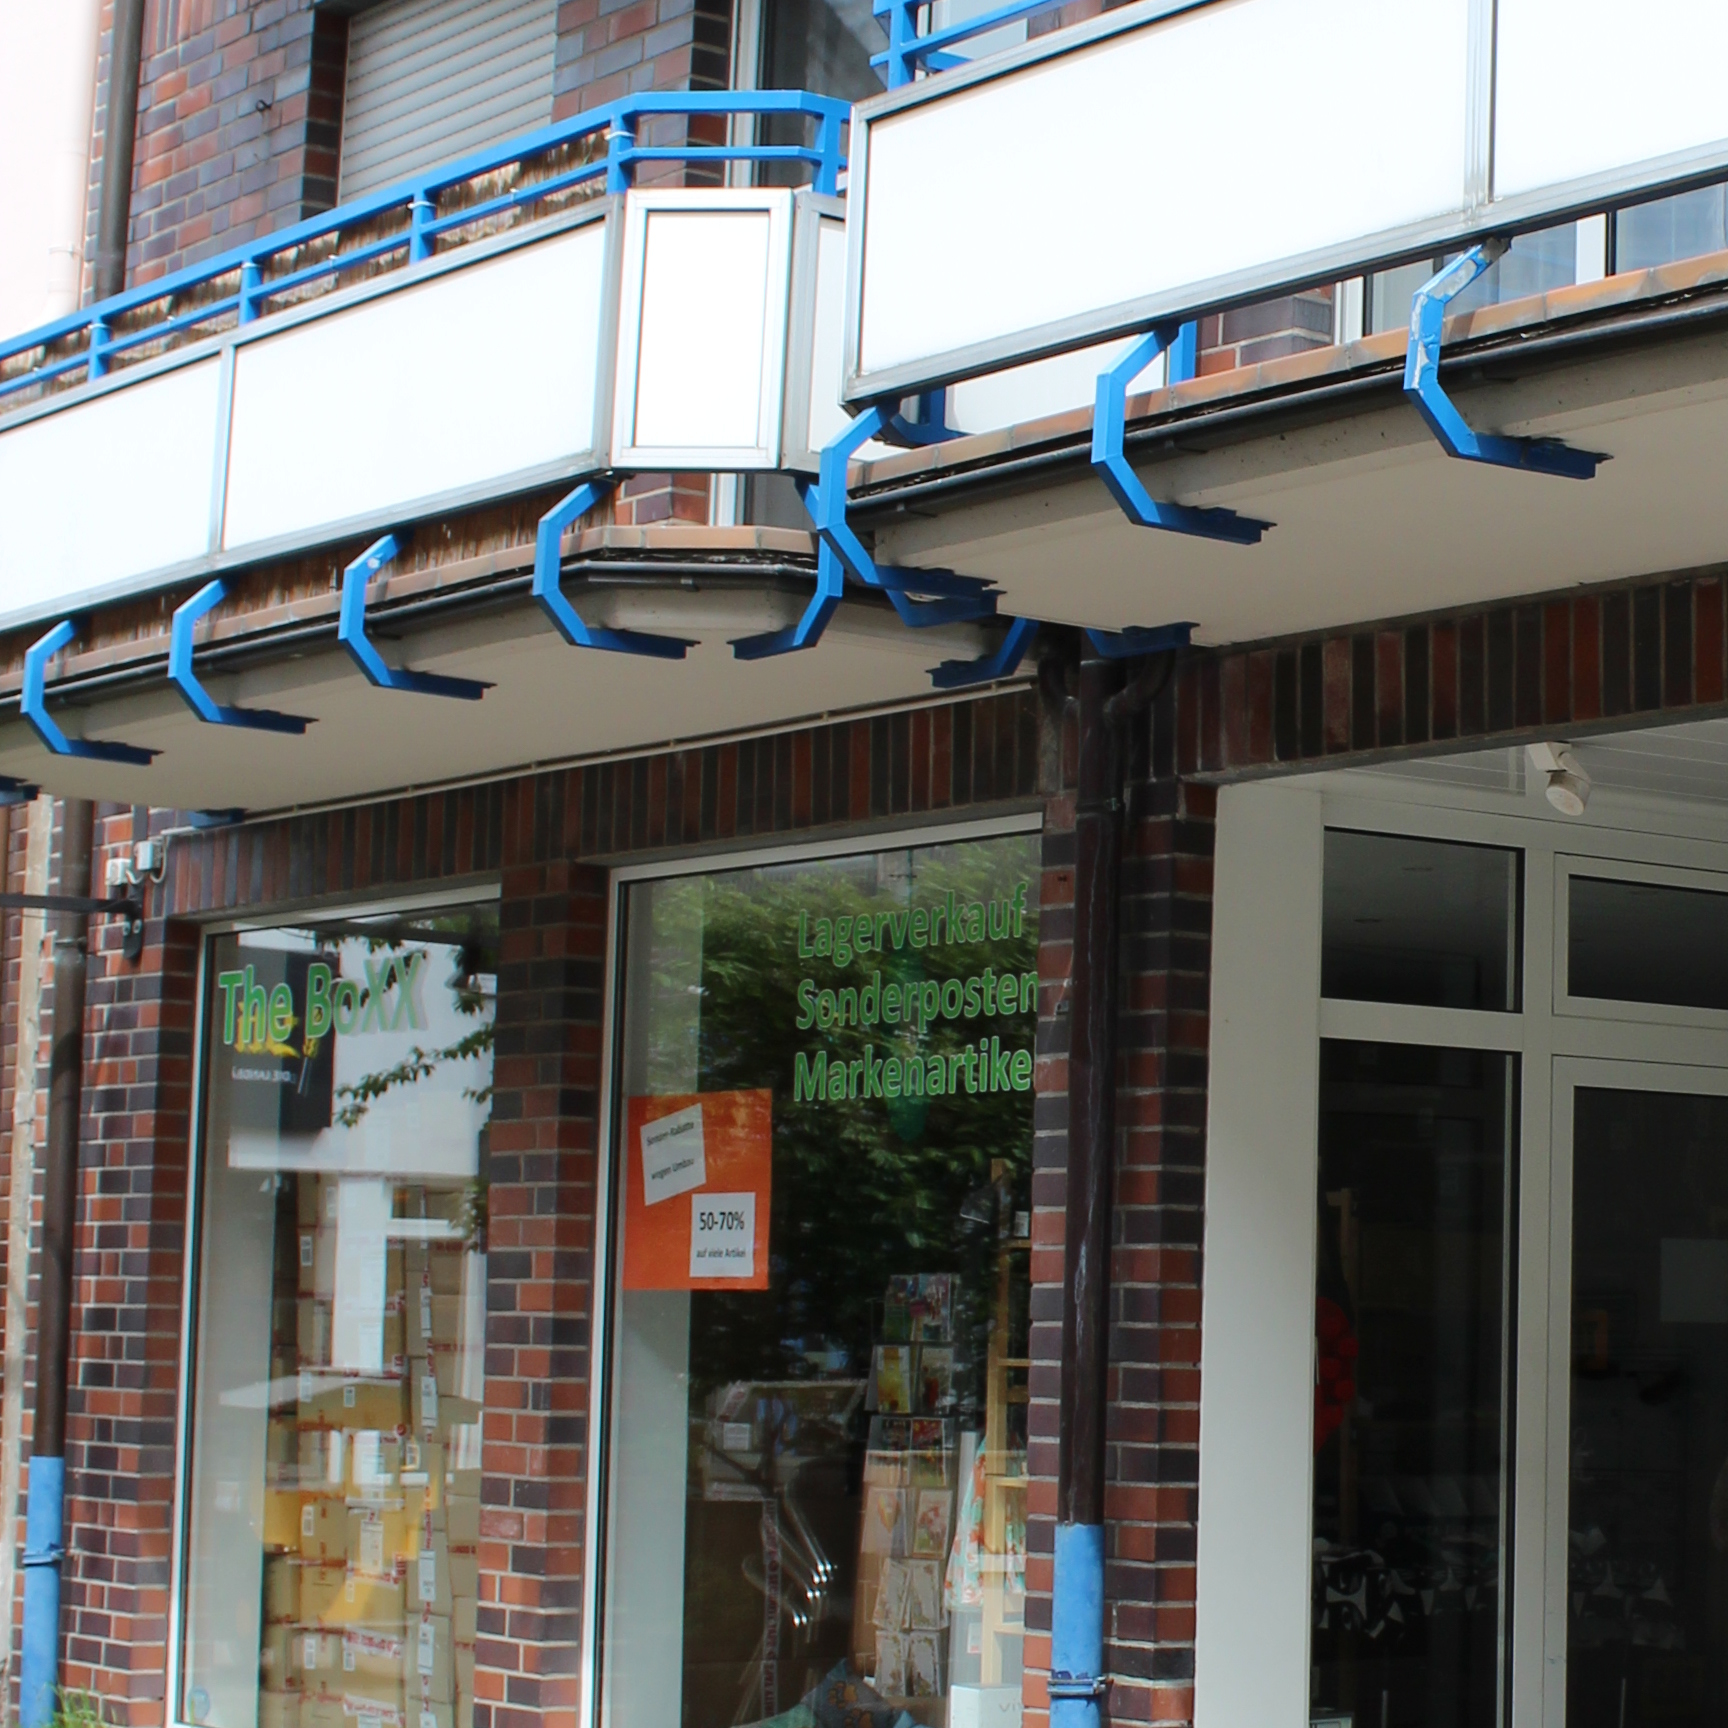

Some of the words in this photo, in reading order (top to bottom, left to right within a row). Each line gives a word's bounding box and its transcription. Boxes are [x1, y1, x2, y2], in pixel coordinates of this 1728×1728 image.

[797, 882, 1028, 968] Lagerverkauf
[218, 963, 293, 1045] The
[305, 952, 425, 1039] BoXX
[795, 966, 1039, 1031] Sonderposten
[699, 1210, 745, 1231] 50-70%
